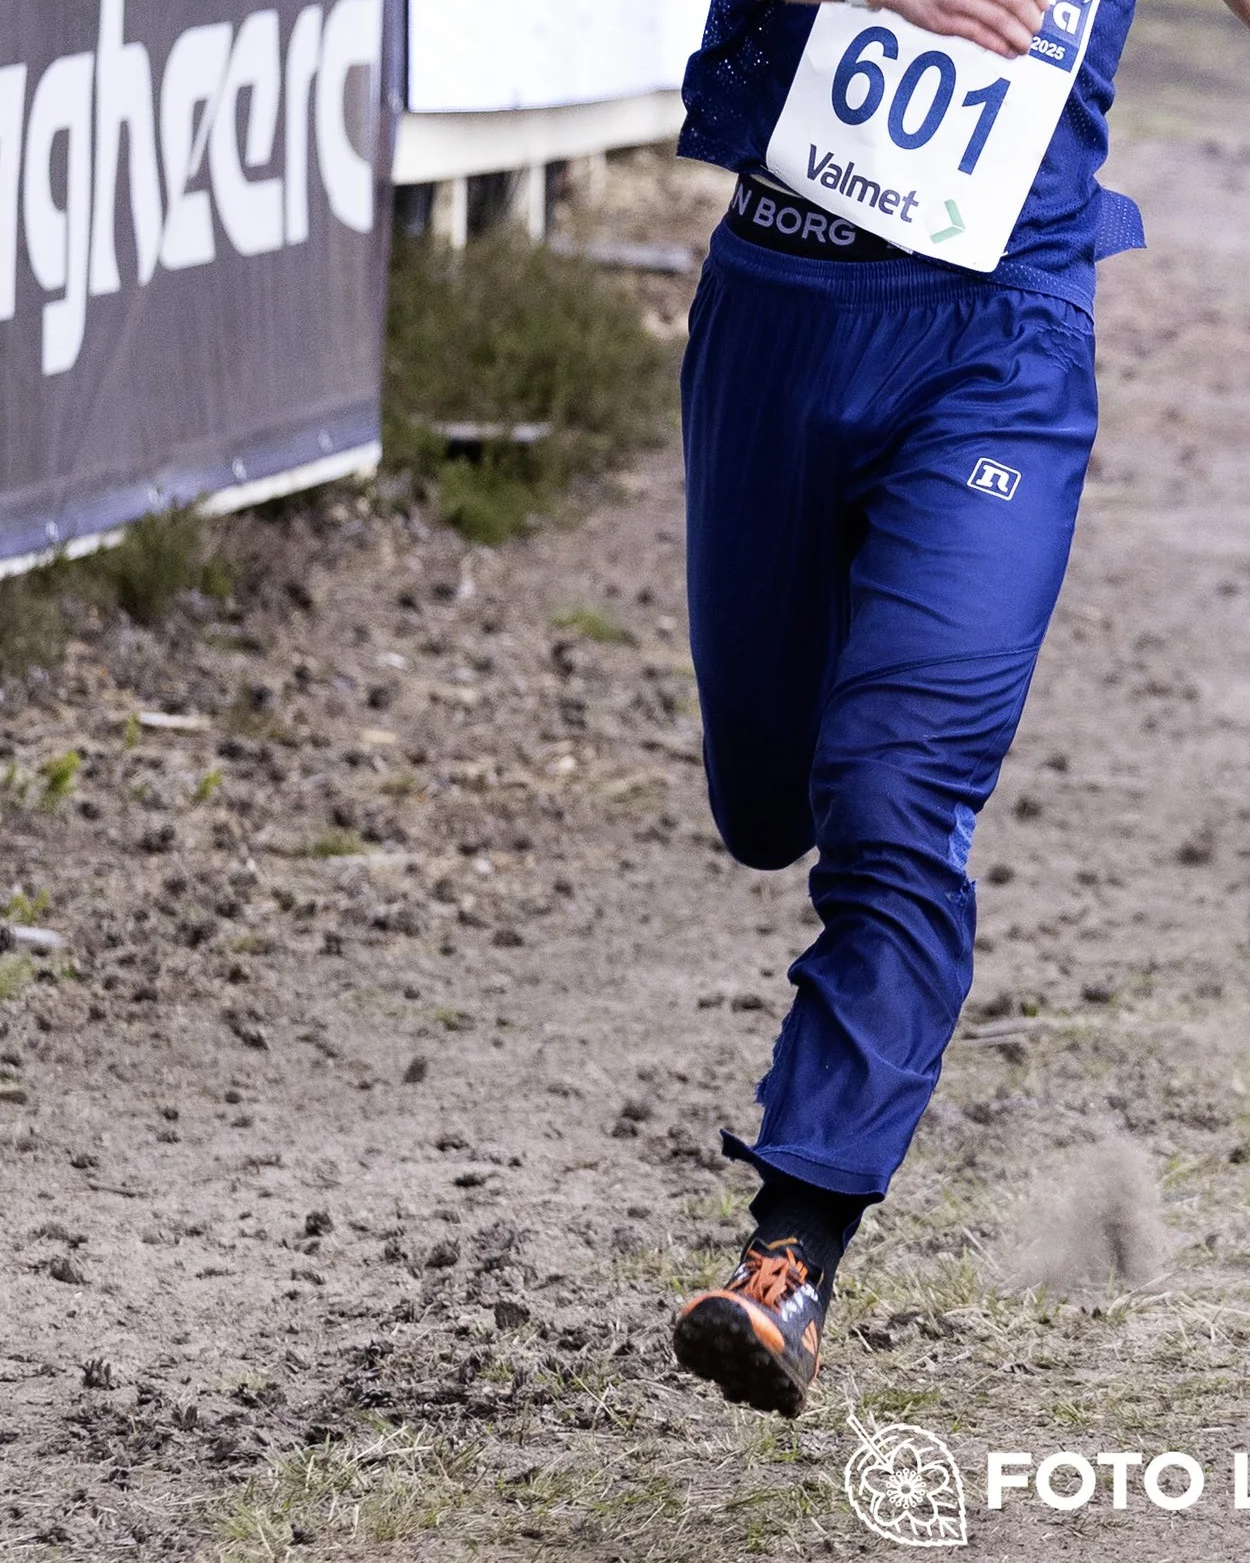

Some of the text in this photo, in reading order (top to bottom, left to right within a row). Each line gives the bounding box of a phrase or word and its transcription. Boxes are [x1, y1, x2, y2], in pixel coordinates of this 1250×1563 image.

[1031, 36, 1066, 60] 2025
[831, 25, 1011, 175] 601
[807, 143, 919, 223] Valmet
[752, 196, 856, 246] BORG
